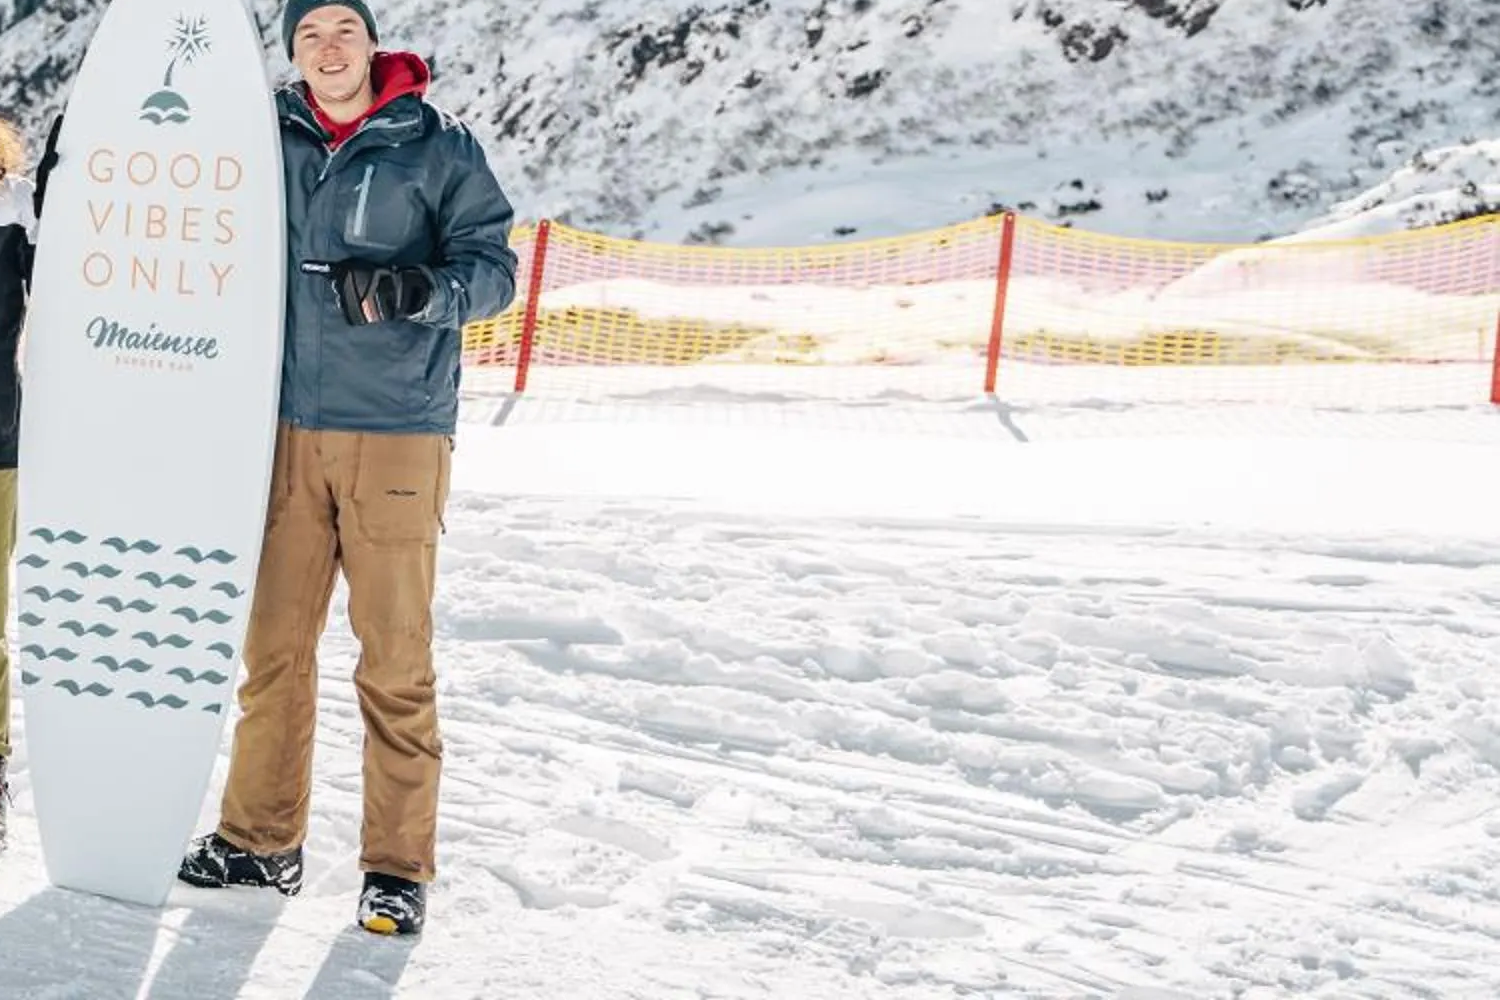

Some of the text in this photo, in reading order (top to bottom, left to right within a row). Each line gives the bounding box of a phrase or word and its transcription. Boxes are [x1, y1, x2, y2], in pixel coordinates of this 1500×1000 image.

[87, 148, 242, 191] GOOD
[87, 199, 235, 245] VIBES
[83, 252, 235, 297] ONLY
[85, 315, 220, 360] Maiensee
